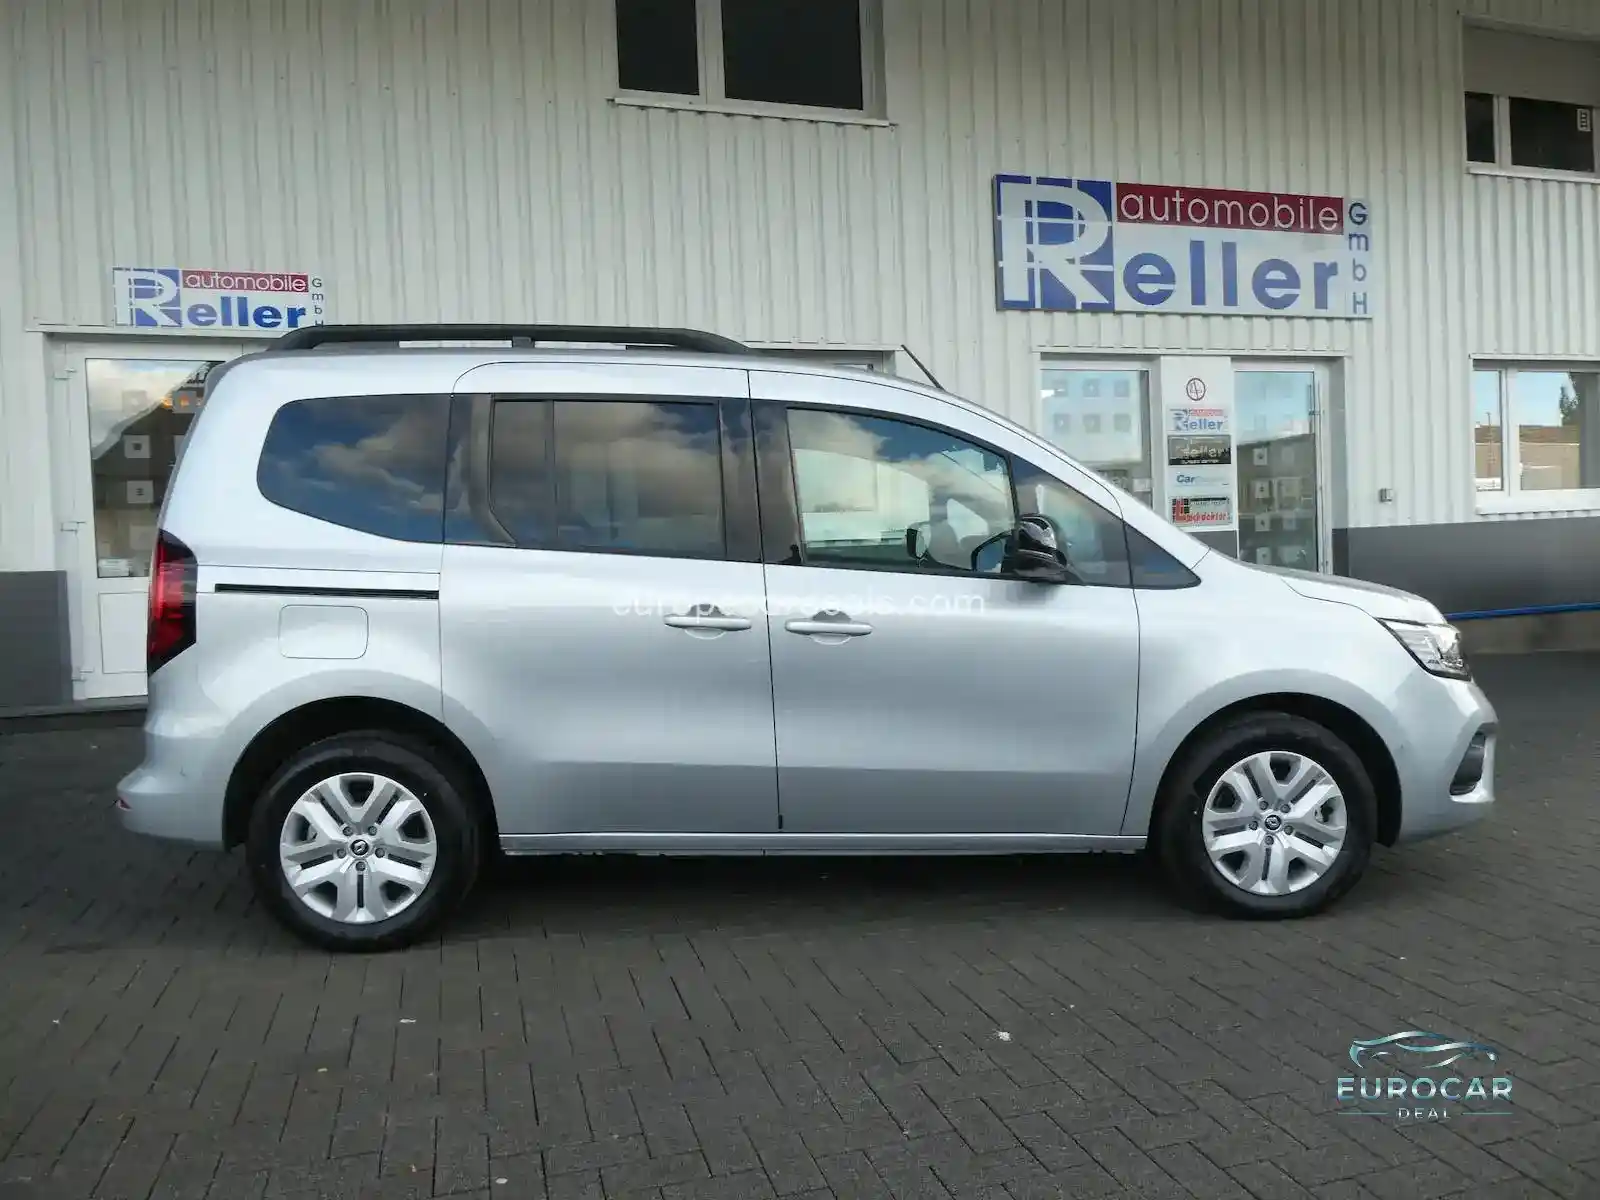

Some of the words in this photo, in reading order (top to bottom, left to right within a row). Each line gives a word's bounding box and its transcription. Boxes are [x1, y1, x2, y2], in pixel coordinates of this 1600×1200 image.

[1119, 189, 1339, 232] automobile
[1347, 201, 1371, 315] GmbH
[184, 271, 307, 292] automobile
[1176, 474, 1196, 484] Car
